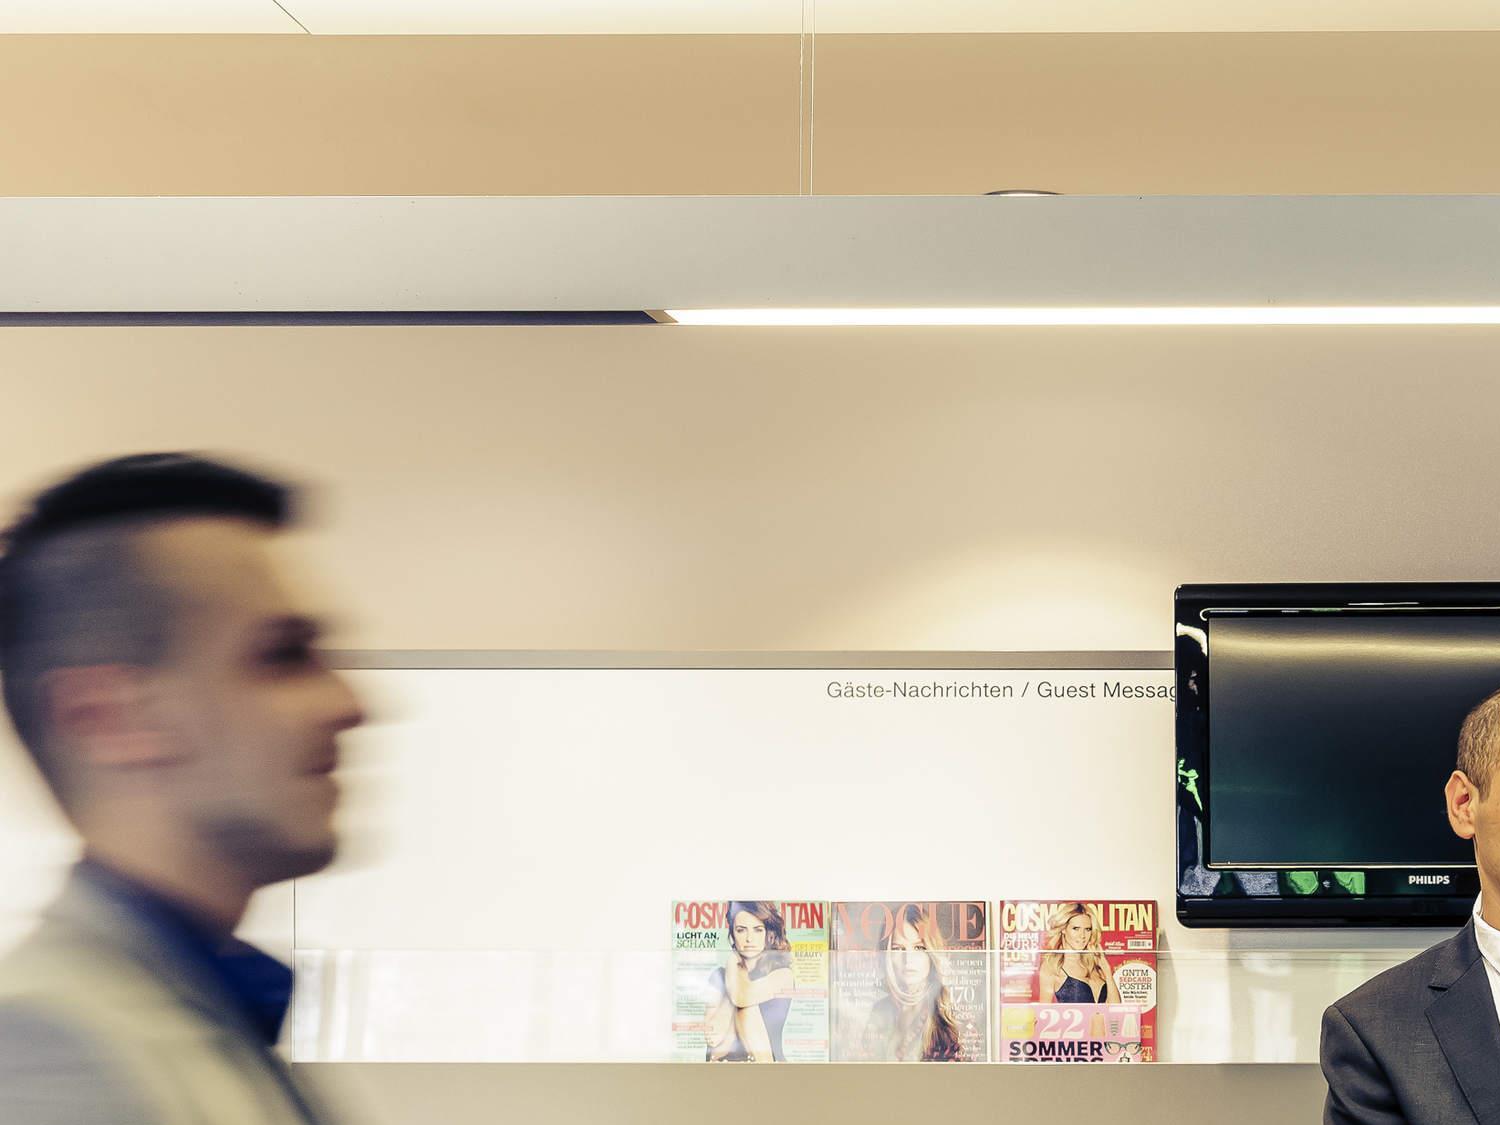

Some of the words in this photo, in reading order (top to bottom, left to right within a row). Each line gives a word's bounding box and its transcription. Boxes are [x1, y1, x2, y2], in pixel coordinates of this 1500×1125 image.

[826, 680, 1013, 699] Gäste-Nachrichten
[1021, 681, 1030, 698] /
[1037, 681, 1096, 699] Guest
[1103, 681, 1175, 702] Messag
[1408, 875, 1451, 885] PHILIPS
[837, 901, 985, 941] VOGUE
[676, 940, 716, 948] SCHAM
[1039, 1008, 1085, 1039] 22
[1009, 1041, 1103, 1056] SOMMER
